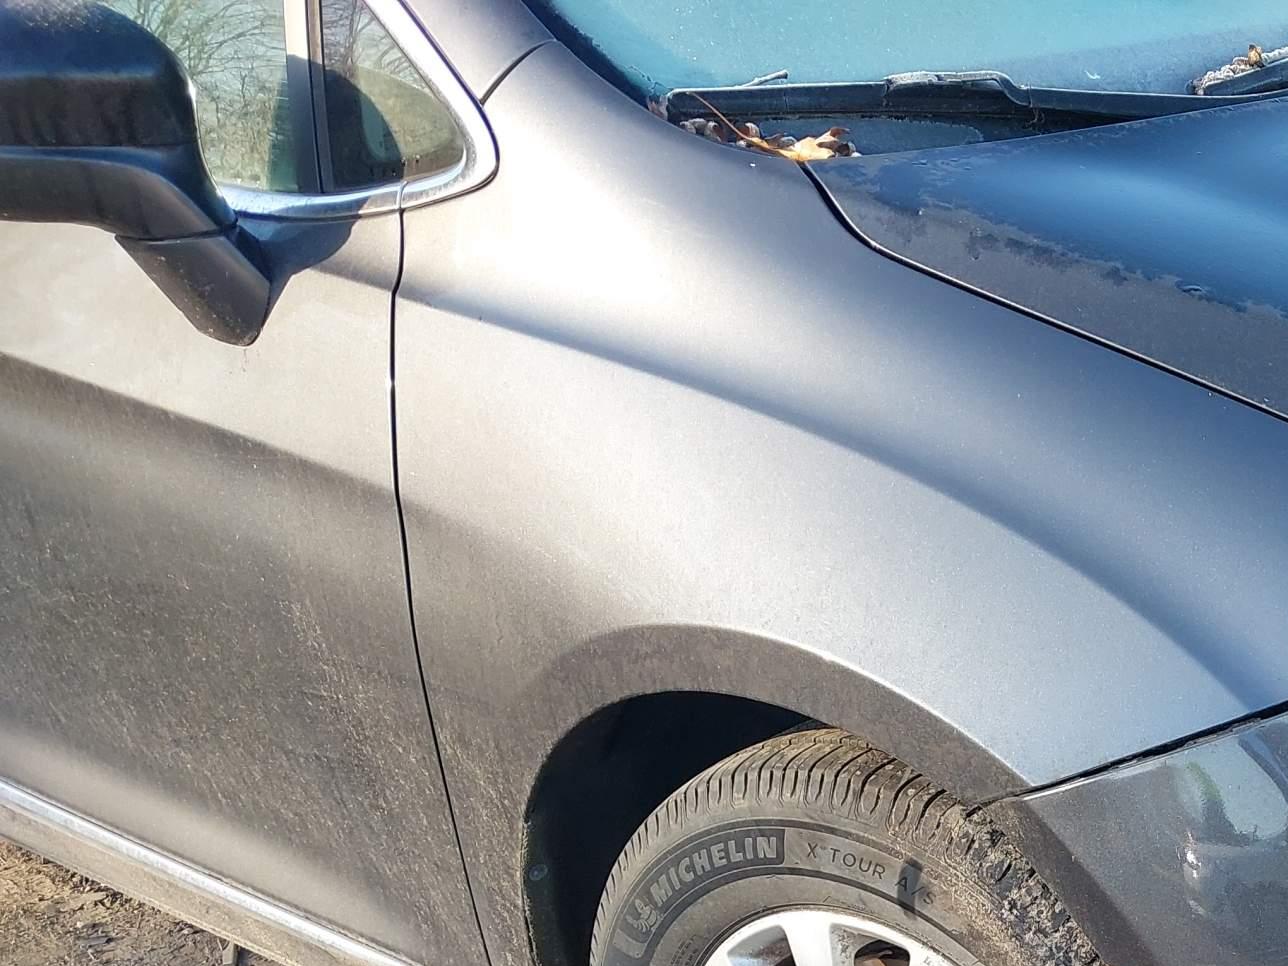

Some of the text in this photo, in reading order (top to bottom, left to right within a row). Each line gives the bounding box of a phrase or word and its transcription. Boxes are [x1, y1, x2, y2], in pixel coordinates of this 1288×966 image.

[650, 835, 777, 904] MICHELIN
[807, 842, 818, 859] X
[830, 848, 886, 880] TOUR
[895, 876, 936, 905] A/S
